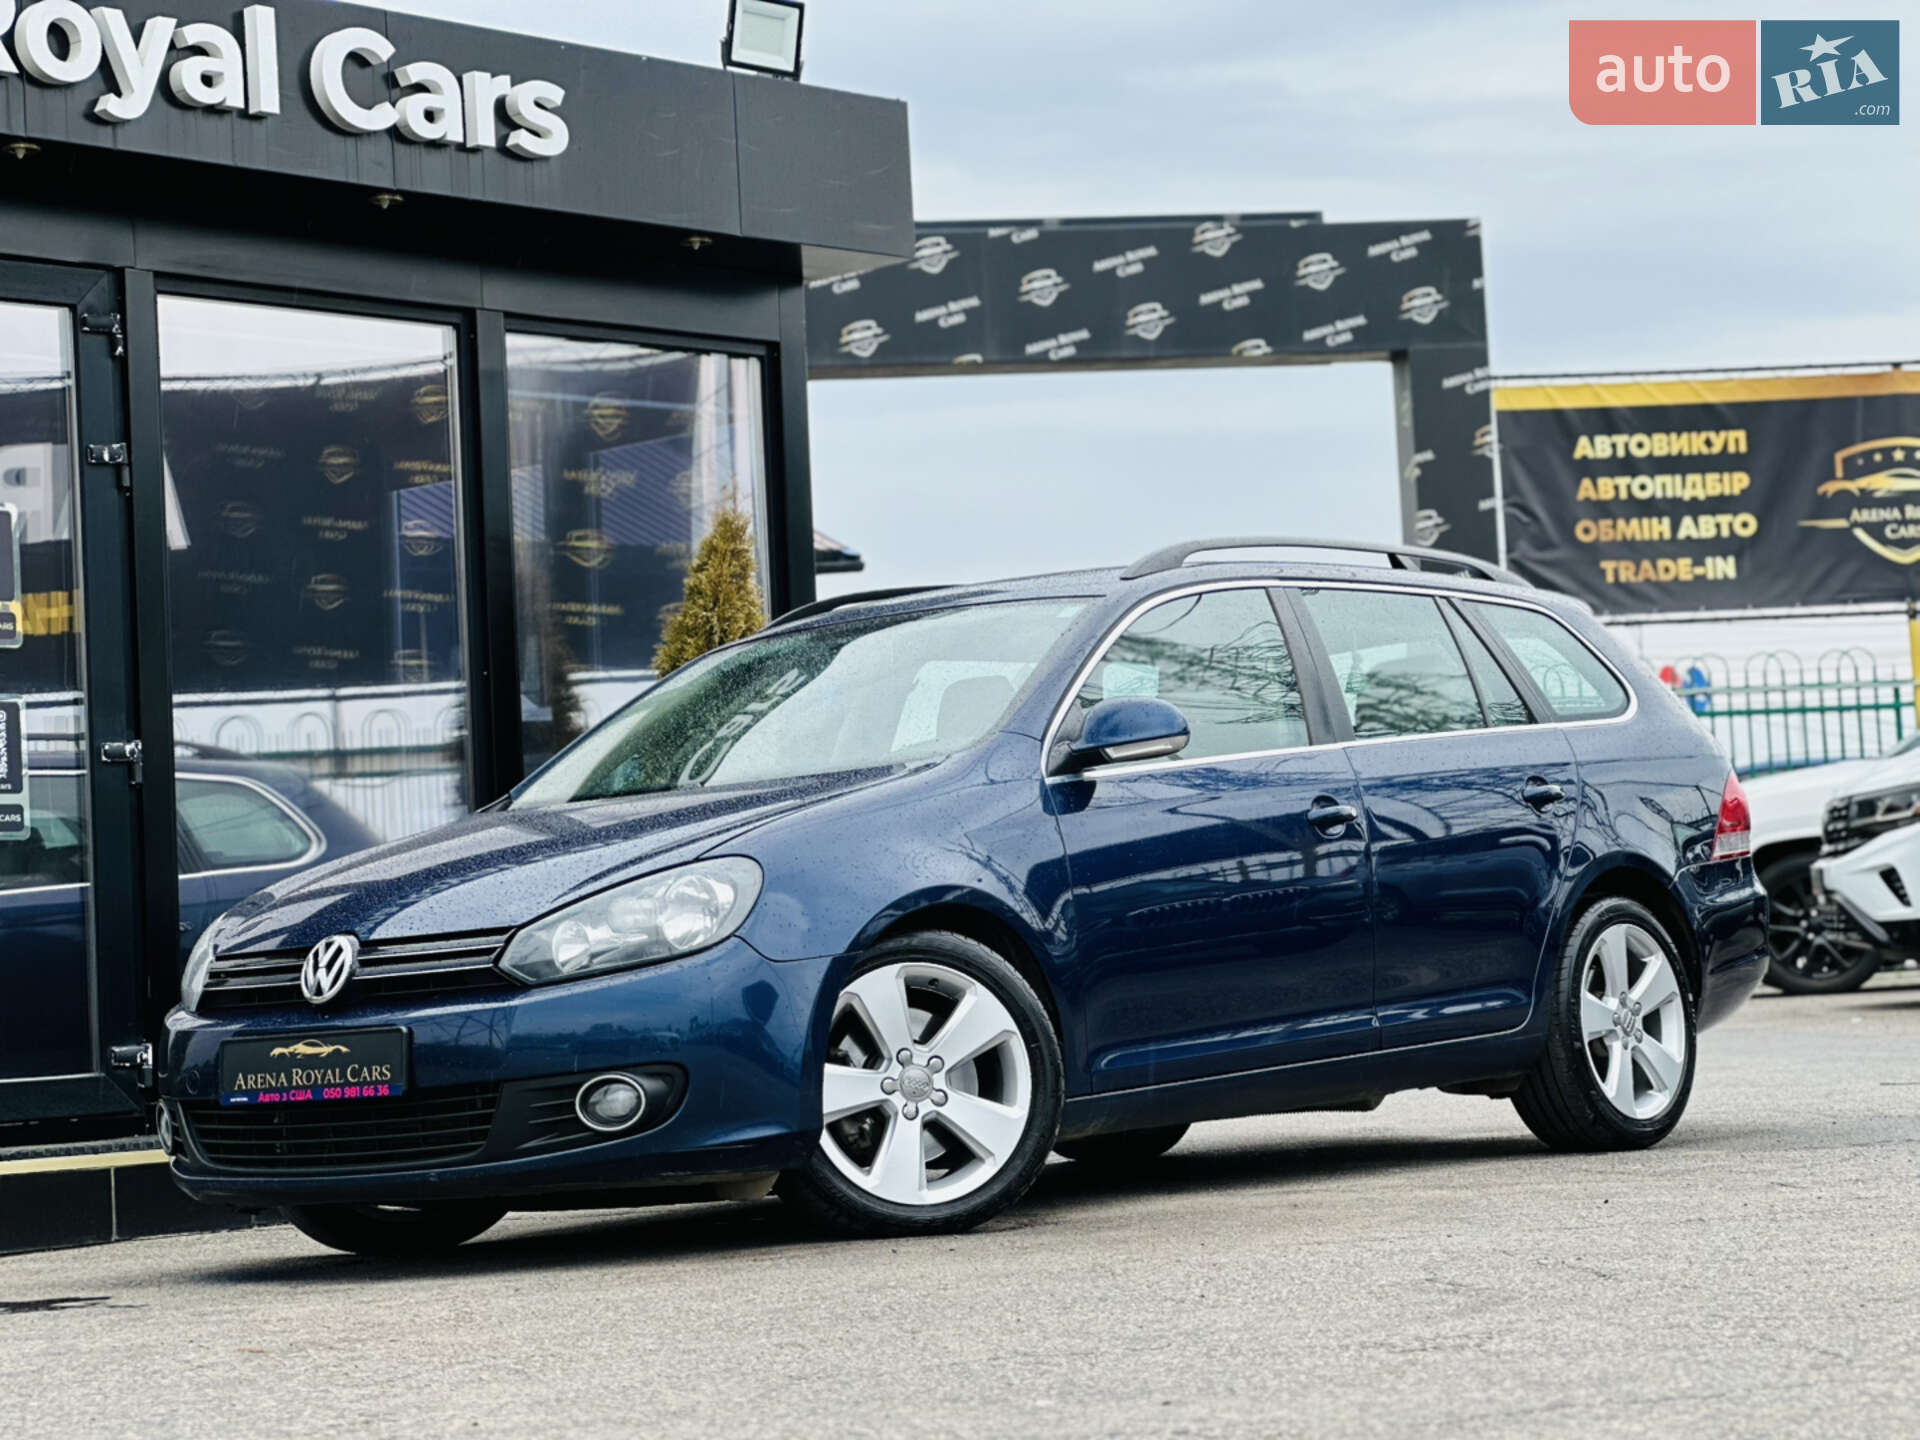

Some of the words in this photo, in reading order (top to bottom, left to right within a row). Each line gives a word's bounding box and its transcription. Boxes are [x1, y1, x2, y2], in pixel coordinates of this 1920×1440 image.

[0, 0, 280, 122] oyal
[310, 27, 569, 158] Cars
[1573, 429, 1748, 459] АВТОВИКУП
[1576, 472, 1751, 501] АВТОПІДБІР
[1574, 517, 1672, 543] ОБМІН
[1676, 513, 1758, 540] АВТО
[1600, 555, 1737, 584] TRADE-IN
[234, 1072, 288, 1090] ARENA
[292, 1068, 344, 1086] ROYAL
[347, 1064, 391, 1082] CARS
[289, 1089, 312, 1101] США
[323, 1087, 342, 1098] 050
